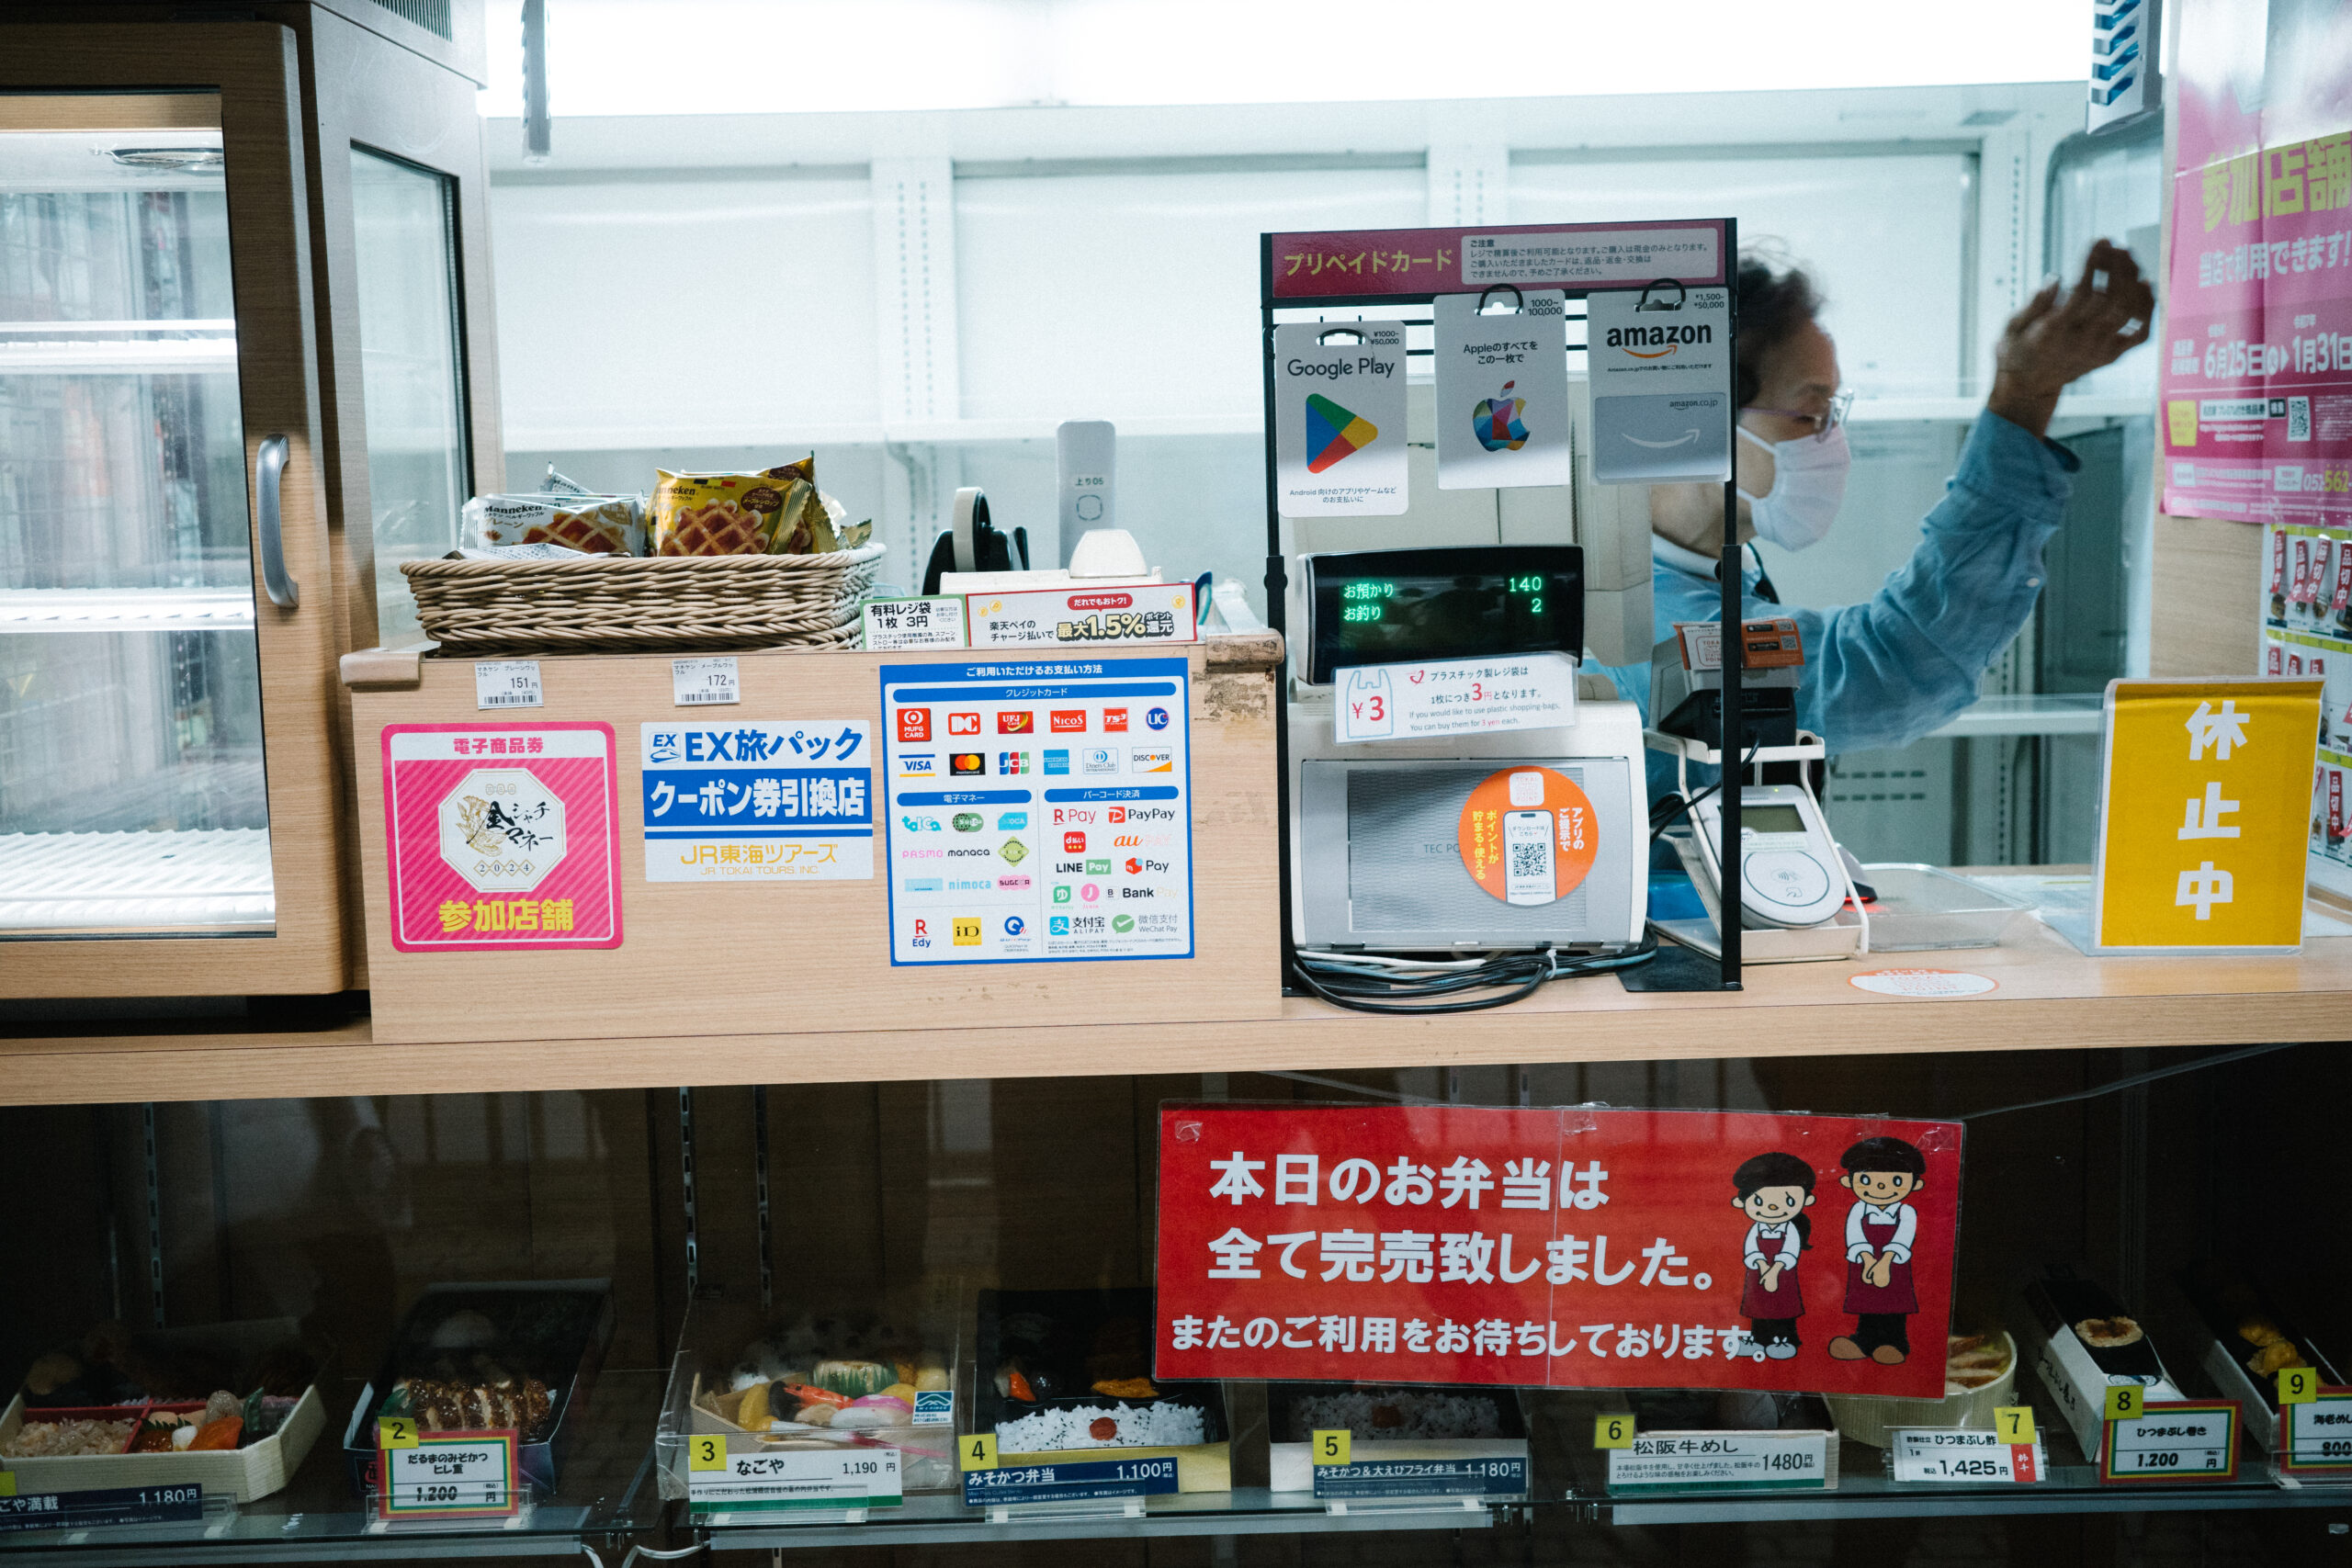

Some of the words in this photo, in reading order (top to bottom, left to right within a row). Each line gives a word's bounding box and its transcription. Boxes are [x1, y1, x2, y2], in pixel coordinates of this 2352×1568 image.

[1470, 239, 1496, 248] ご注意
[1283, 248, 1453, 277] プリペイドカード
[1606, 323, 1712, 348] amazon
[1463, 340, 1539, 355] Appleのすべてを
[1477, 353, 1525, 365] この一枚で
[1287, 357, 1353, 380] Google
[1358, 357, 1396, 378] Play
[1343, 582, 1394, 600] お預かり
[1510, 576, 1543, 592] 140
[870, 602, 932, 617] 有料レジ袋
[1343, 605, 1381, 622] お釣り
[1531, 598, 1543, 614] 2
[876, 616, 899, 629] 1枚
[906, 615, 928, 627] 3円
[989, 620, 1036, 631] 楽天ペイの
[990, 630, 1055, 642] チャージ払いで
[967, 664, 1102, 678] ご利用いただけるお支払い方法
[1430, 667, 1529, 682] プラスチック製レジ袋は
[510, 677, 528, 689] 151
[707, 674, 727, 686] 172
[1005, 687, 1068, 698] クレジットカード
[453, 737, 545, 755] 電子商品券
[652, 734, 677, 749] EX
[684, 727, 865, 762] EX旅パック
[903, 761, 932, 771] VISA
[999, 759, 1029, 768] JCB
[650, 776, 865, 818] クーポン券引換店
[943, 793, 985, 804] 電子マネー
[1083, 789, 1140, 800] バーコード決済
[1069, 808, 1097, 825] Pay
[1128, 808, 1176, 822] PayPay
[2175, 699, 2252, 920] 休止中
[1114, 835, 1144, 847] au
[1486, 809, 1499, 864] ポイントが
[680, 843, 839, 864] JR東海ツアーズ
[902, 850, 944, 859] PASMO
[947, 849, 990, 857] manaca
[1423, 843, 1443, 854] TEC
[700, 866, 716, 875] JR
[719, 866, 752, 875] TOKAI
[1056, 863, 1083, 873] LINE
[1089, 863, 1109, 873] Pay
[1146, 860, 1170, 874] Pay
[948, 878, 991, 890] nimoca
[1123, 887, 1155, 898] Bank
[438, 897, 574, 933] 参加店舗
[1072, 916, 1105, 929] 支付宝
[1139, 925, 1165, 933] WeChat
[1166, 925, 1178, 933] Pay
[912, 938, 932, 948] Edy
[1207, 1150, 1611, 1212] 本日のお弁当は
[1205, 1226, 1713, 1293] 全て完売致しました。
[1170, 1314, 1768, 1364] またのご利用をお待ちしております。
[2290, 1373, 2304, 1395] 9
[2117, 1391, 2132, 1411] 8
[391, 1421, 406, 1440] 2
[1609, 1420, 1623, 1440] 6
[2007, 1413, 2020, 1435] 7
[2137, 1426, 2207, 1438] ひつまぶし巻き
[701, 1441, 715, 1462] 3
[971, 1440, 986, 1461] 4
[1325, 1436, 1339, 1457] 5
[1633, 1439, 1738, 1455] 松阪牛めし
[408, 1453, 489, 1465] だるまのみそかつ
[2206, 1459, 2217, 1468] 円
[434, 1464, 464, 1474] ヒレ重
[736, 1459, 785, 1476] なごや
[842, 1461, 877, 1475] 1,190
[886, 1462, 897, 1472] 円
[1939, 1460, 1996, 1477] 1,425
[967, 1467, 1056, 1486] みそかつ弁当
[485, 1492, 496, 1503] 円
